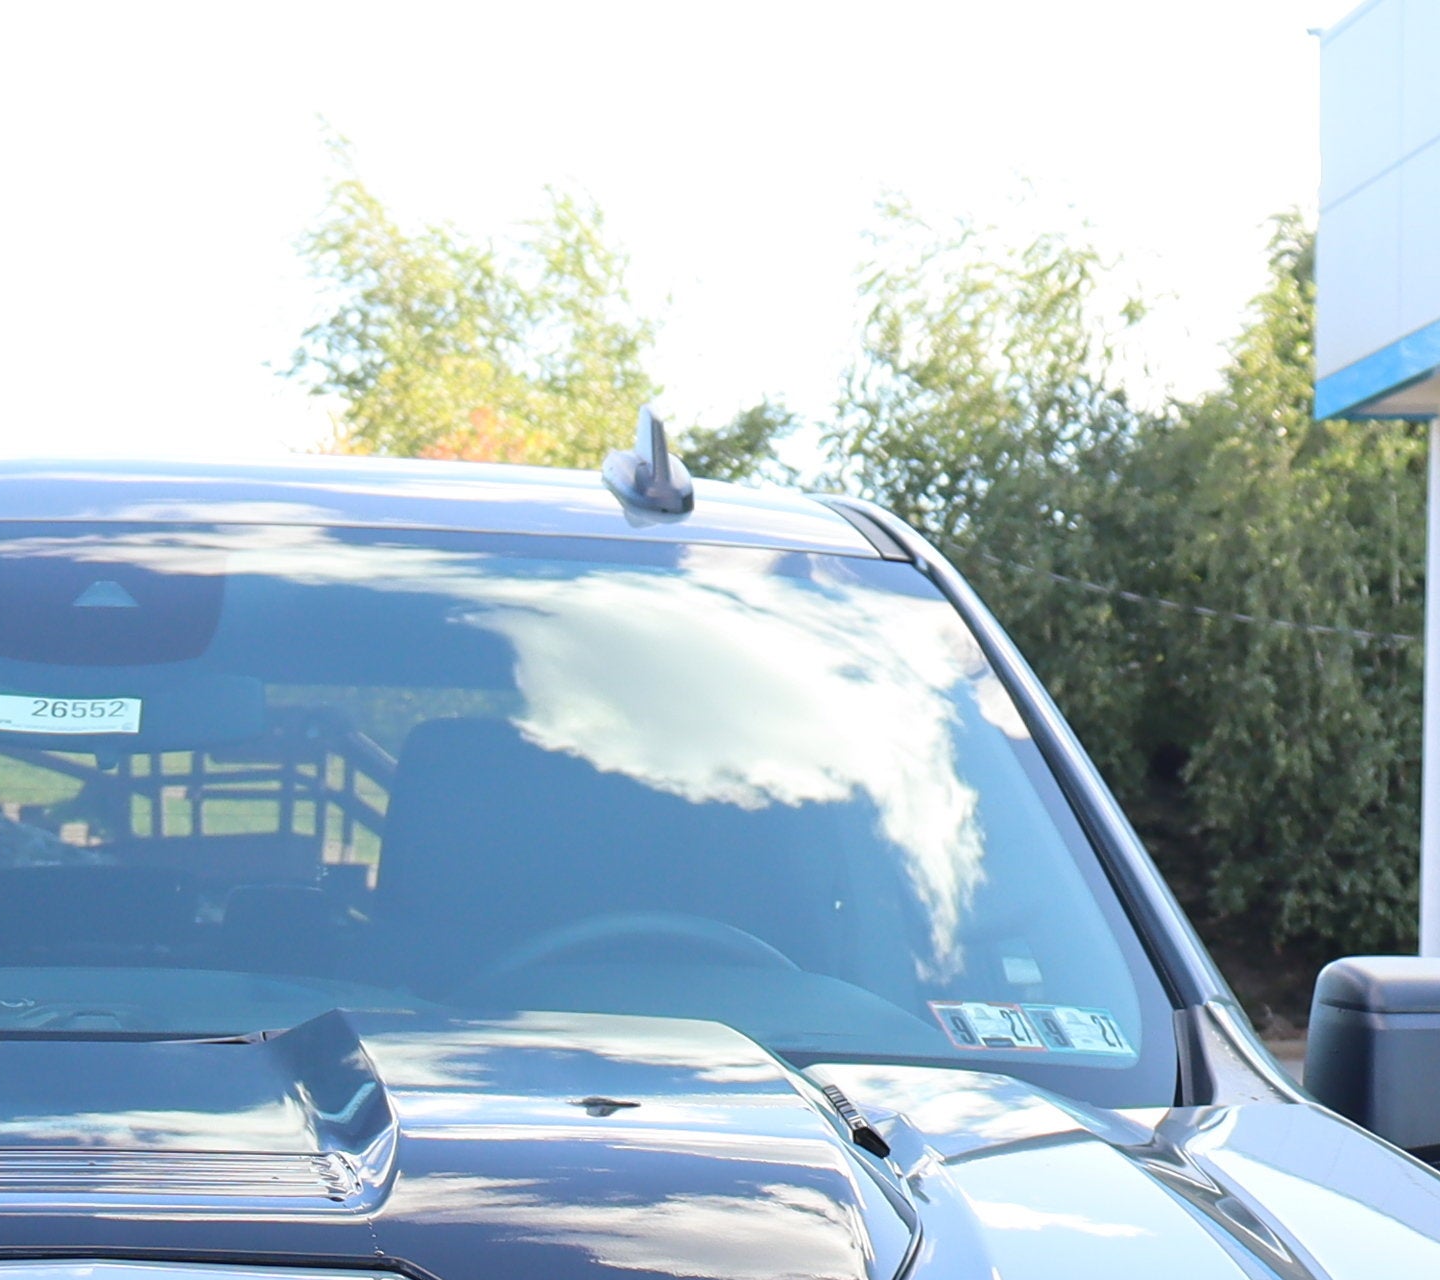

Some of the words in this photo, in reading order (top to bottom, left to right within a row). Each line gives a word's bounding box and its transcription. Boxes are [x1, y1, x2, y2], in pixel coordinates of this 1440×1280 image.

[31, 699, 126, 719] 26552
[1000, 1009, 1033, 1045] 27
[1089, 1014, 1124, 1048] 27
